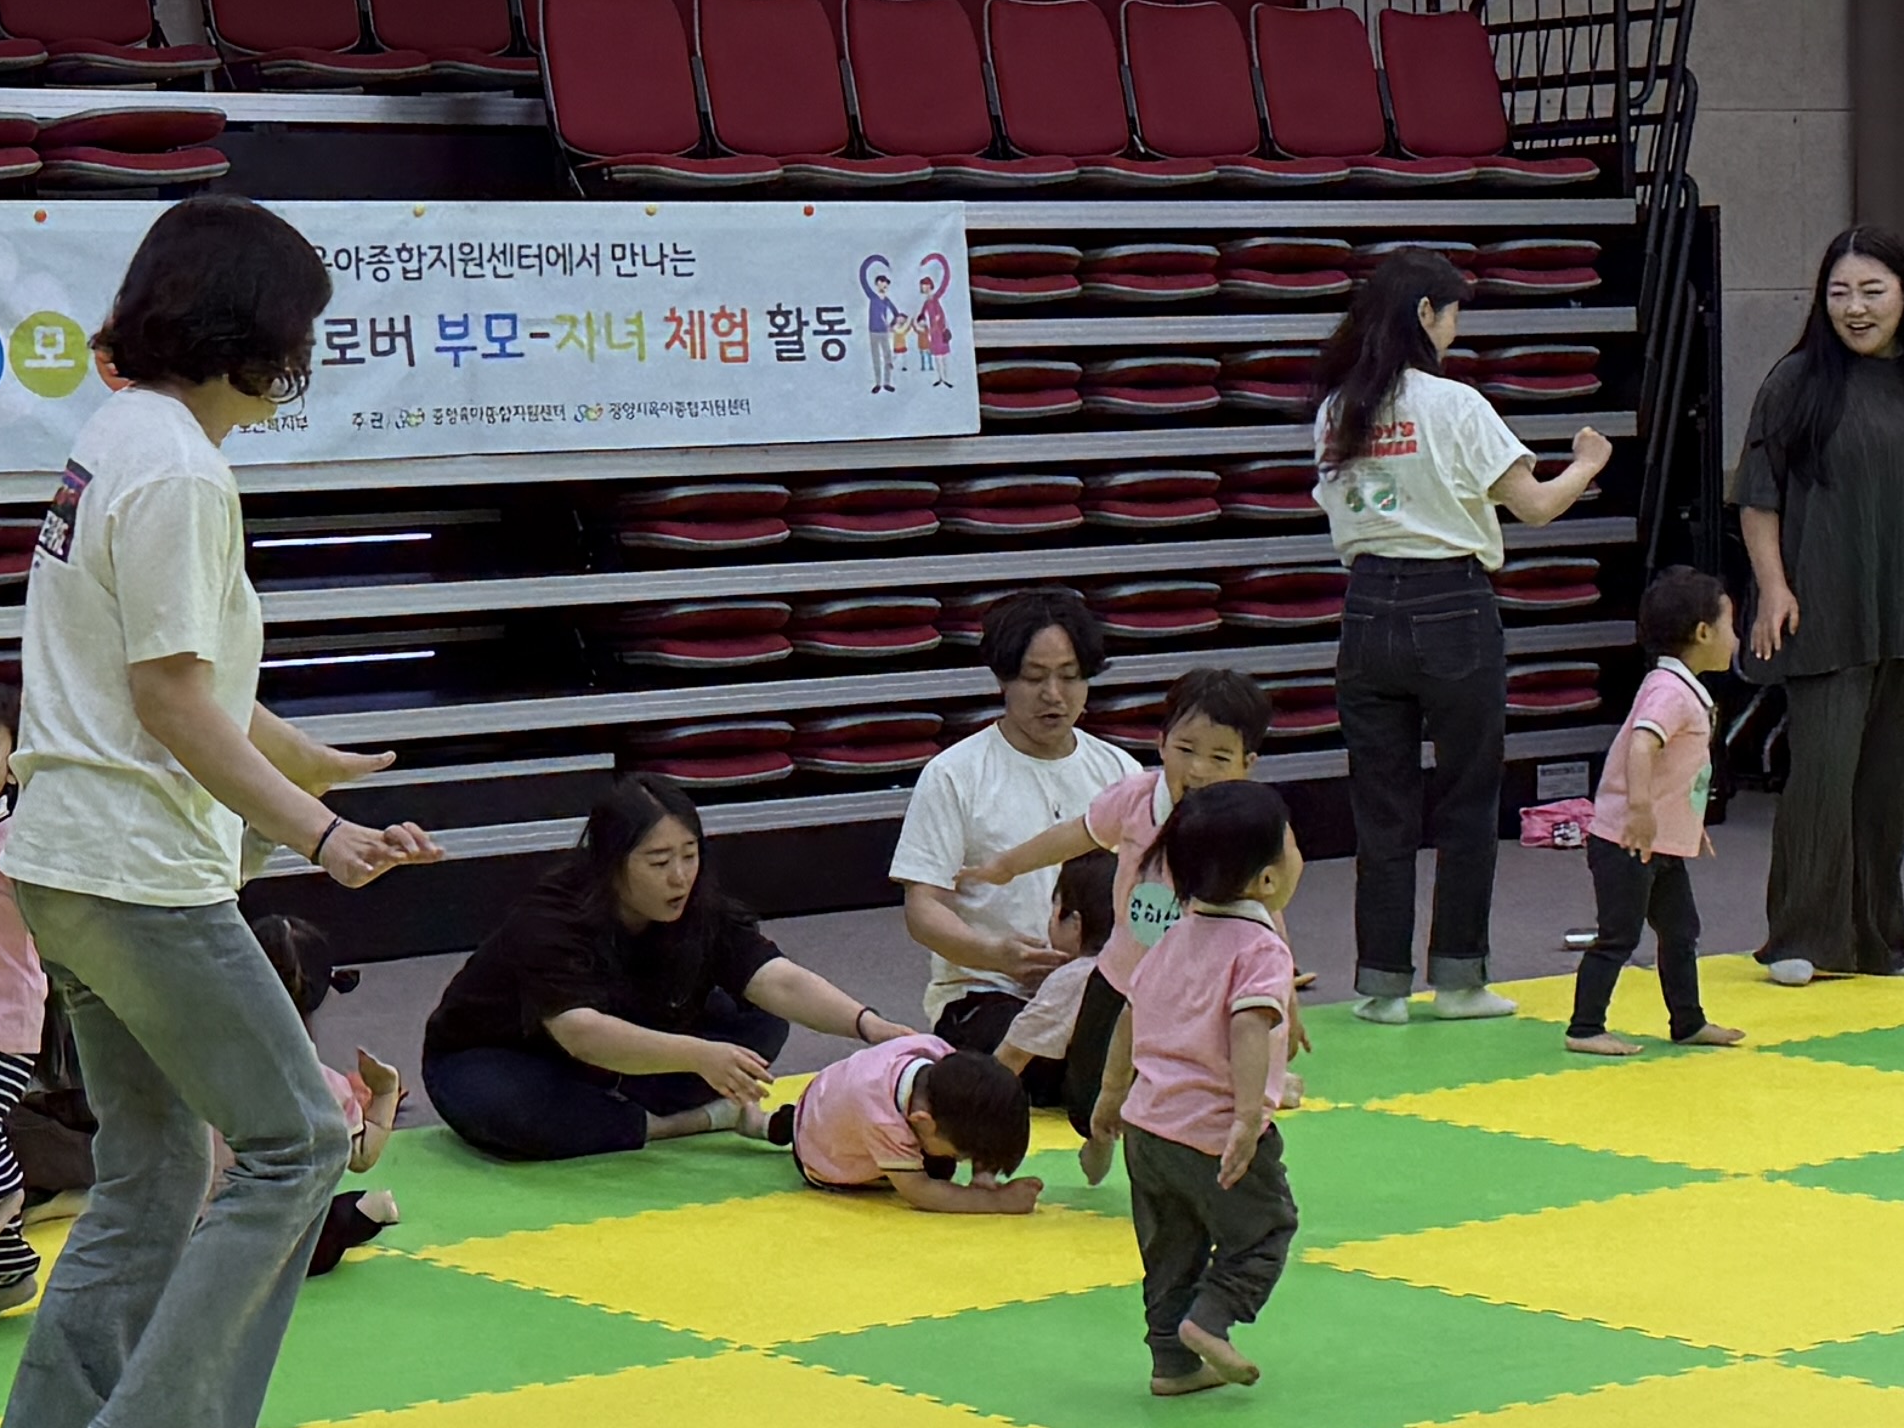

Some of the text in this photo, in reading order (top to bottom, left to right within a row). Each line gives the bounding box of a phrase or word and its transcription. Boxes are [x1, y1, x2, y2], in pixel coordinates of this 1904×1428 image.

[611, 242, 696, 278] 만나는
[320, 314, 415, 367] 로버
[435, 310, 646, 367] 부모-자녀
[663, 304, 749, 364] 체험
[766, 303, 853, 362] 활동
